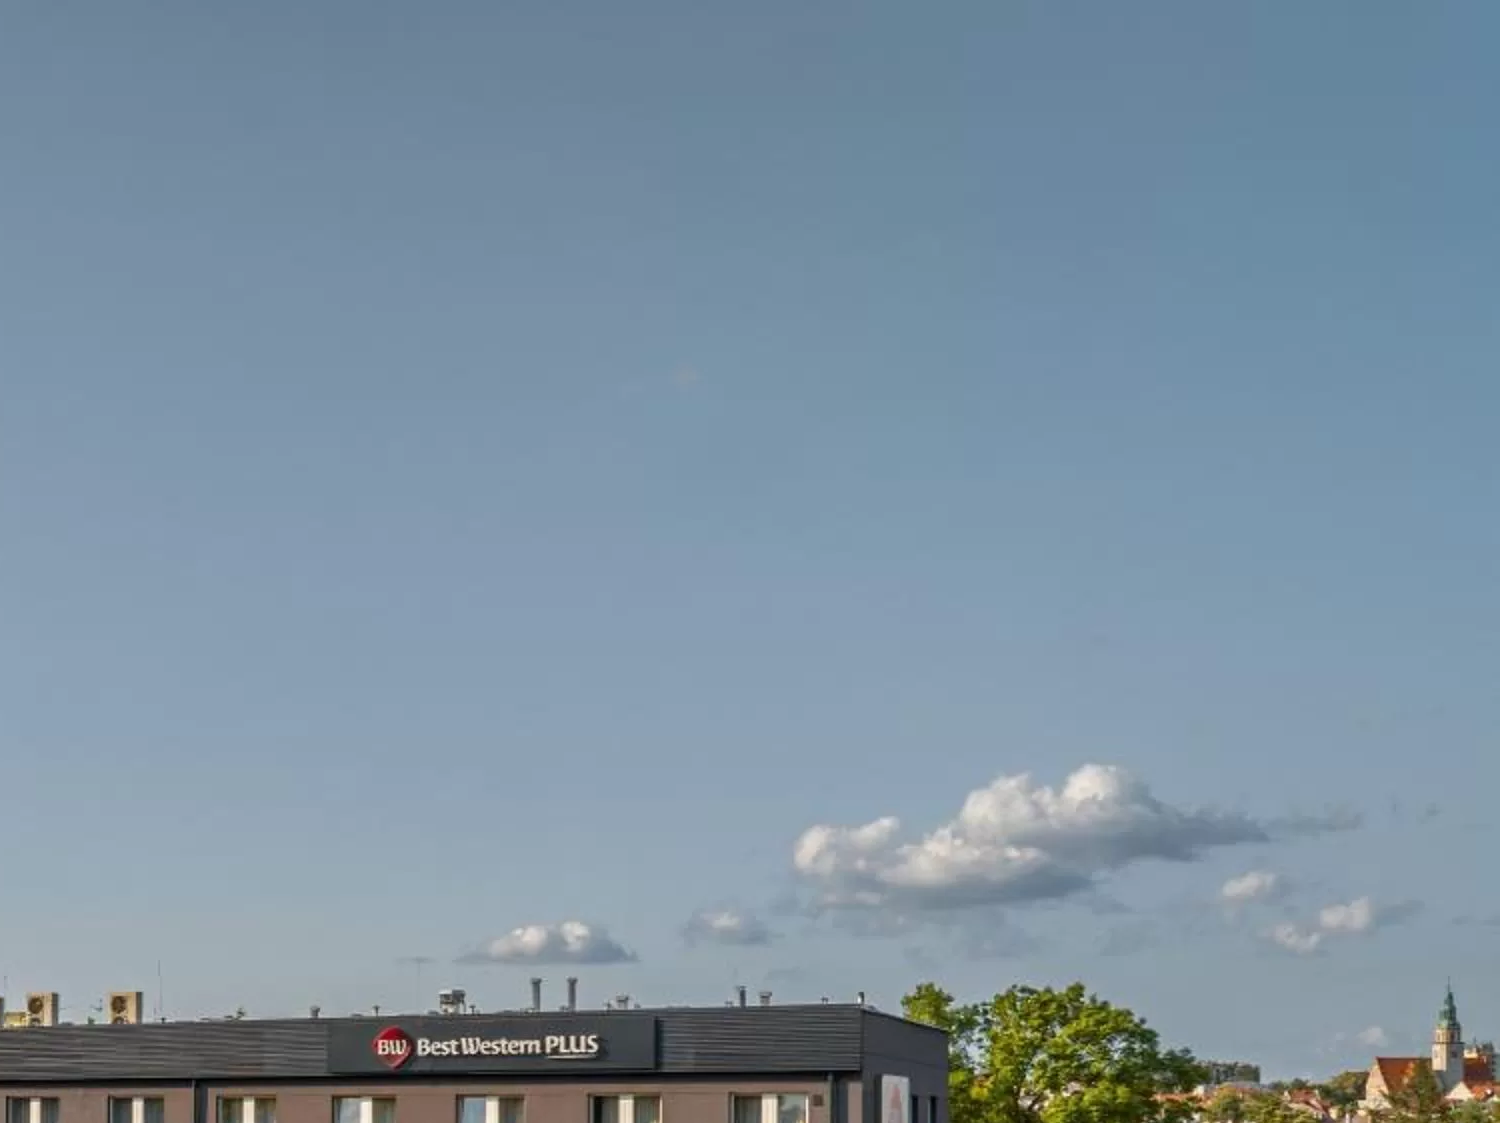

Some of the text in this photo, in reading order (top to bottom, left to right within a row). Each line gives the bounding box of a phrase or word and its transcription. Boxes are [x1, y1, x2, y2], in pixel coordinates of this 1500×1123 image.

[377, 1039, 407, 1056] BW
[416, 1034, 599, 1056] Best Western PLUS
